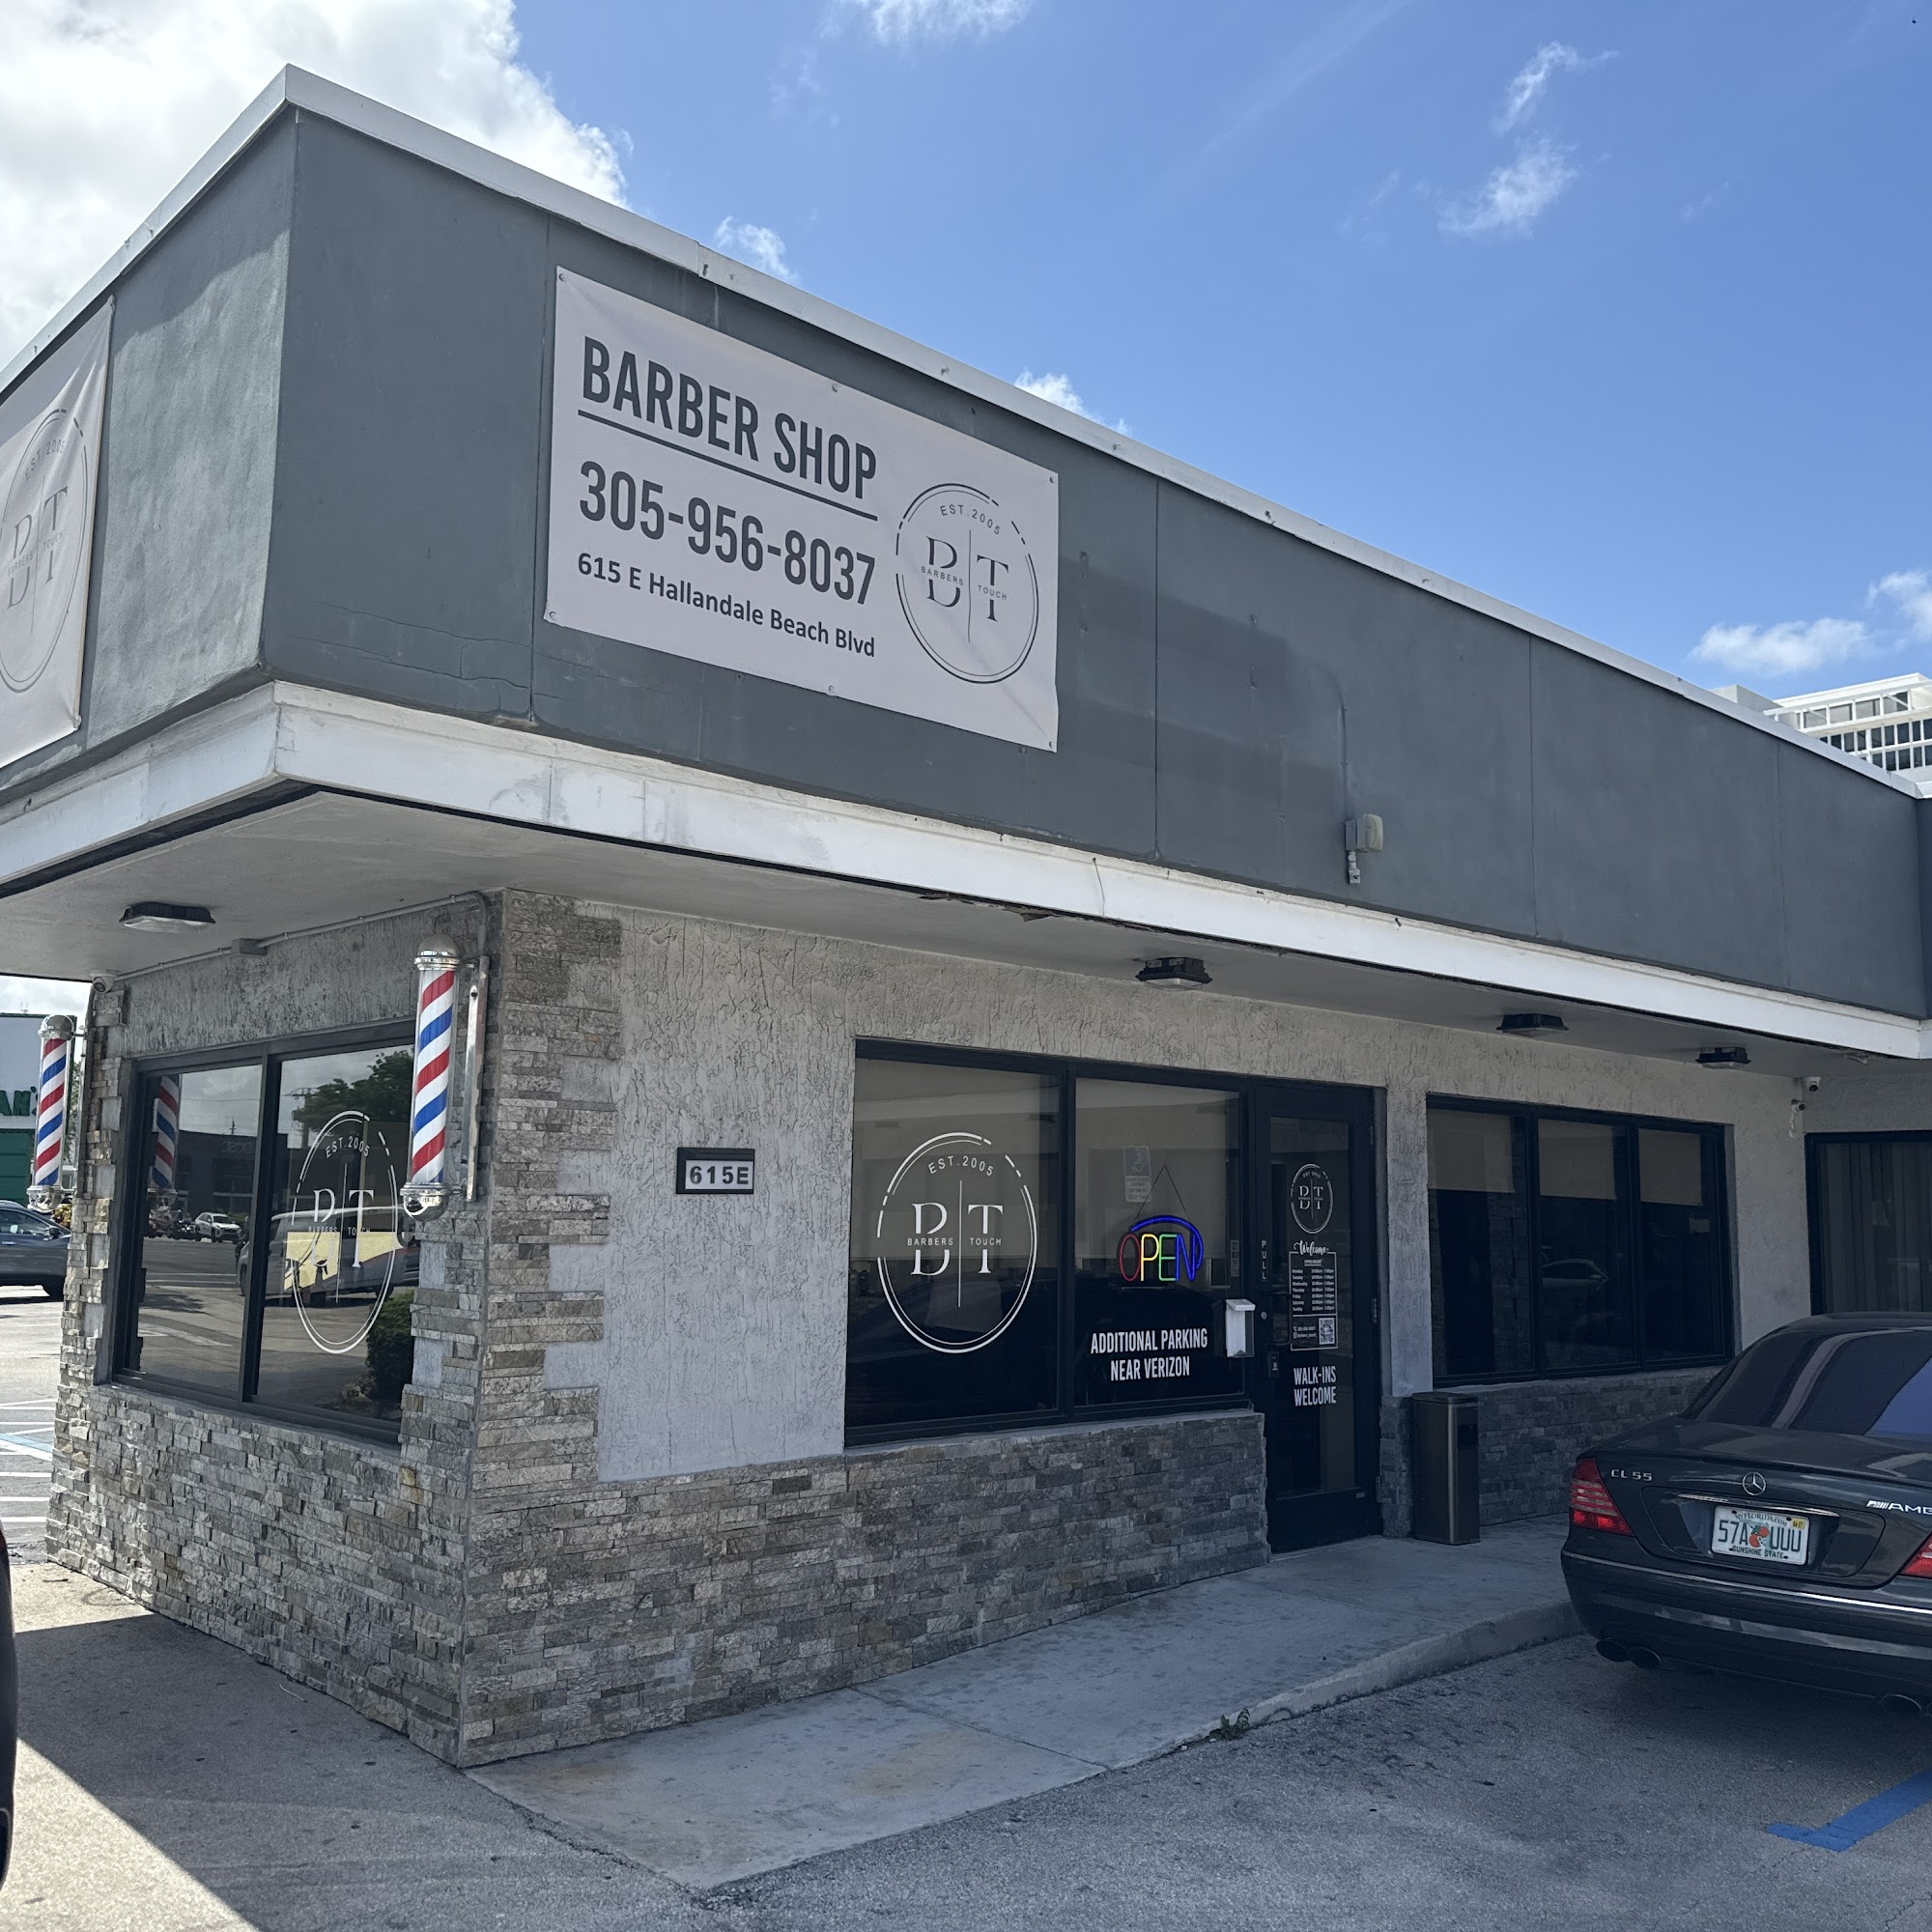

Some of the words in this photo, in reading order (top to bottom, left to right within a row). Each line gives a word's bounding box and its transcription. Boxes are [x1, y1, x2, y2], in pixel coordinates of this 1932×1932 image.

[582, 335, 759, 462] BARBER
[774, 412, 876, 499] SHOP
[580, 460, 875, 605] 305-956-8037
[921, 565, 964, 586] BARBERS
[978, 584, 1008, 600] TOUCH
[578, 553, 621, 583] 615
[630, 566, 641, 590] E
[649, 572, 763, 626] Hallandale
[770, 608, 829, 644] Beach
[836, 627, 875, 657] Blvd
[690, 1165, 749, 1184] 615E
[907, 1237, 953, 1246] BARBERS
[969, 1237, 1002, 1246] TOUCH
[1293, 1239, 1329, 1256] Welcome
[1120, 1234, 1197, 1282] OPEN
[1090, 1330, 1158, 1354] ADDITIONAL
[1161, 1328, 1208, 1350] PARKING
[1110, 1358, 1141, 1381] NEAR
[1144, 1355, 1190, 1378] VERIZON
[1293, 1365, 1337, 1385] WALK-INS
[1293, 1386, 1337, 1406] WELCOME
[1610, 1468, 1628, 1479] CL
[1632, 1471, 1653, 1482] 55
[1718, 1520, 1748, 1546] 57A
[1770, 1526, 1802, 1552] UUU
[1732, 1545, 1762, 1556] SUNSHINE
[1764, 1549, 1784, 1559] STATE
